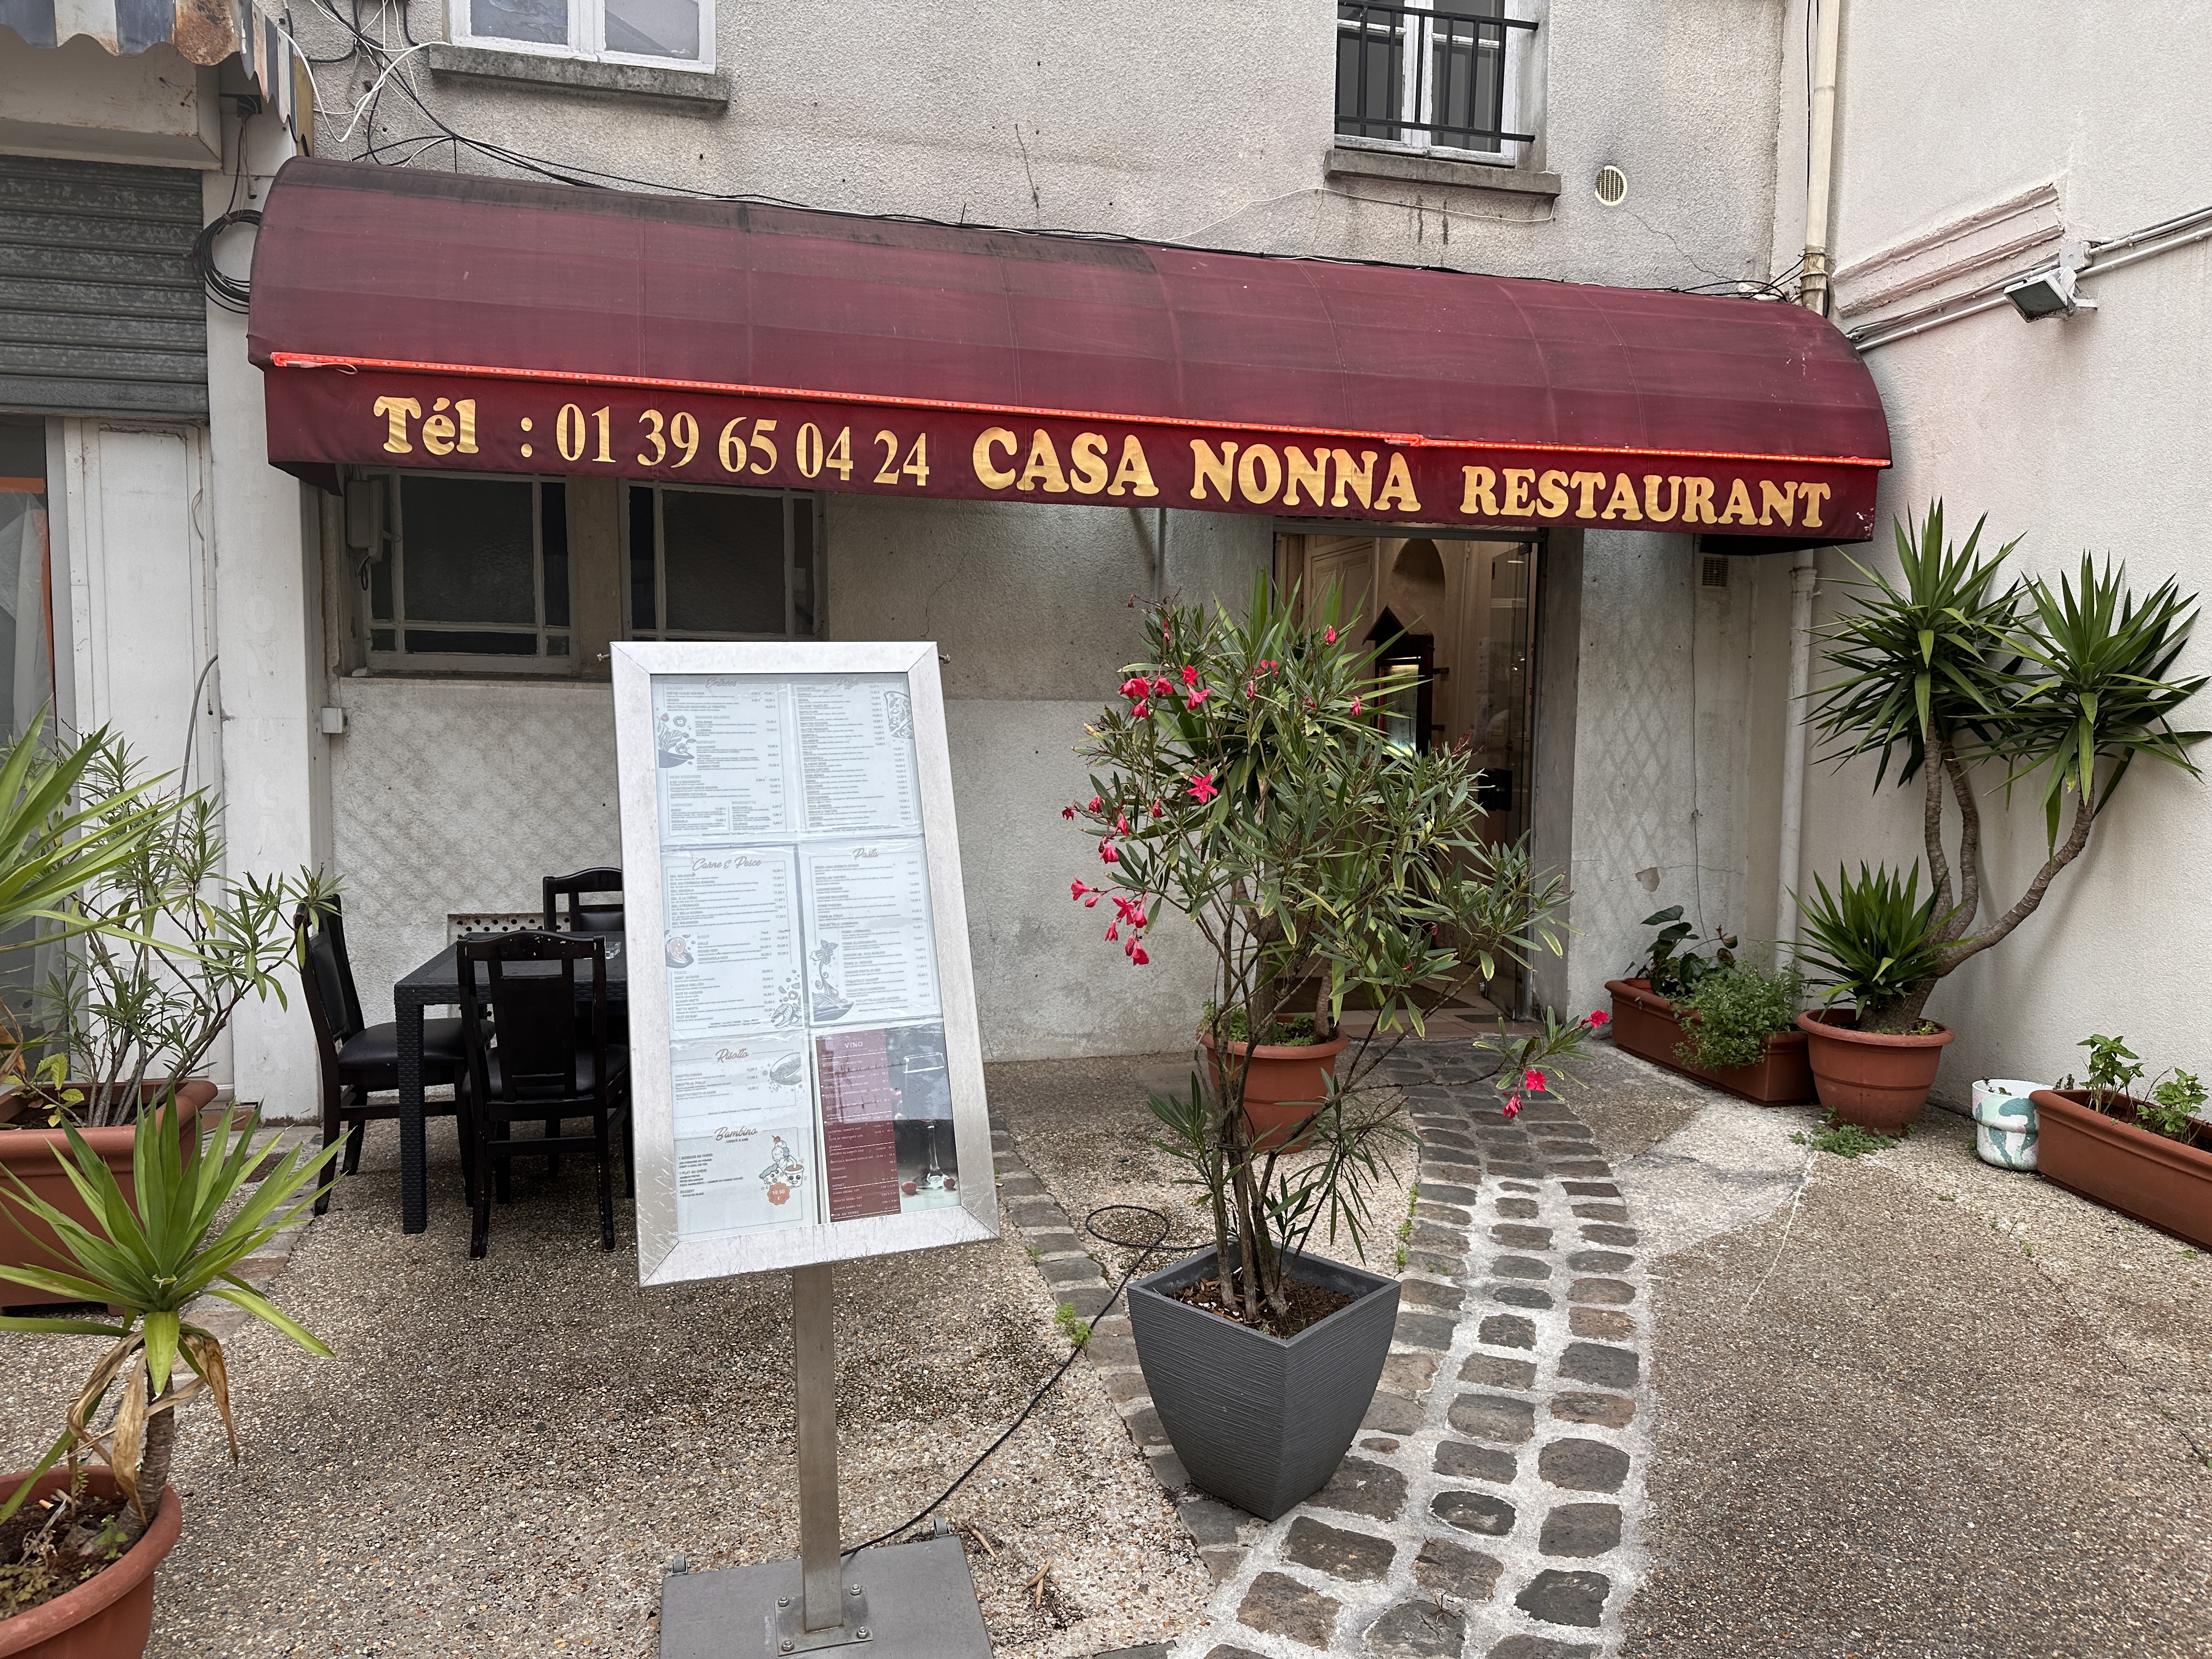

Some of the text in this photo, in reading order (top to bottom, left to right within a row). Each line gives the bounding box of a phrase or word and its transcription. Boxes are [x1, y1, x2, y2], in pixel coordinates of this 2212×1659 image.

[373, 396, 930, 486] Tél : 01 39 65 04 24
[972, 427, 1831, 527] CASA NONNA RESTAURANT
[853, 848, 879, 860] Pasta
[692, 858, 723, 871] Carne
[734, 856, 761, 868] Pesce
[715, 1048, 749, 1063] Risotto
[714, 1126, 758, 1141] Bambino
